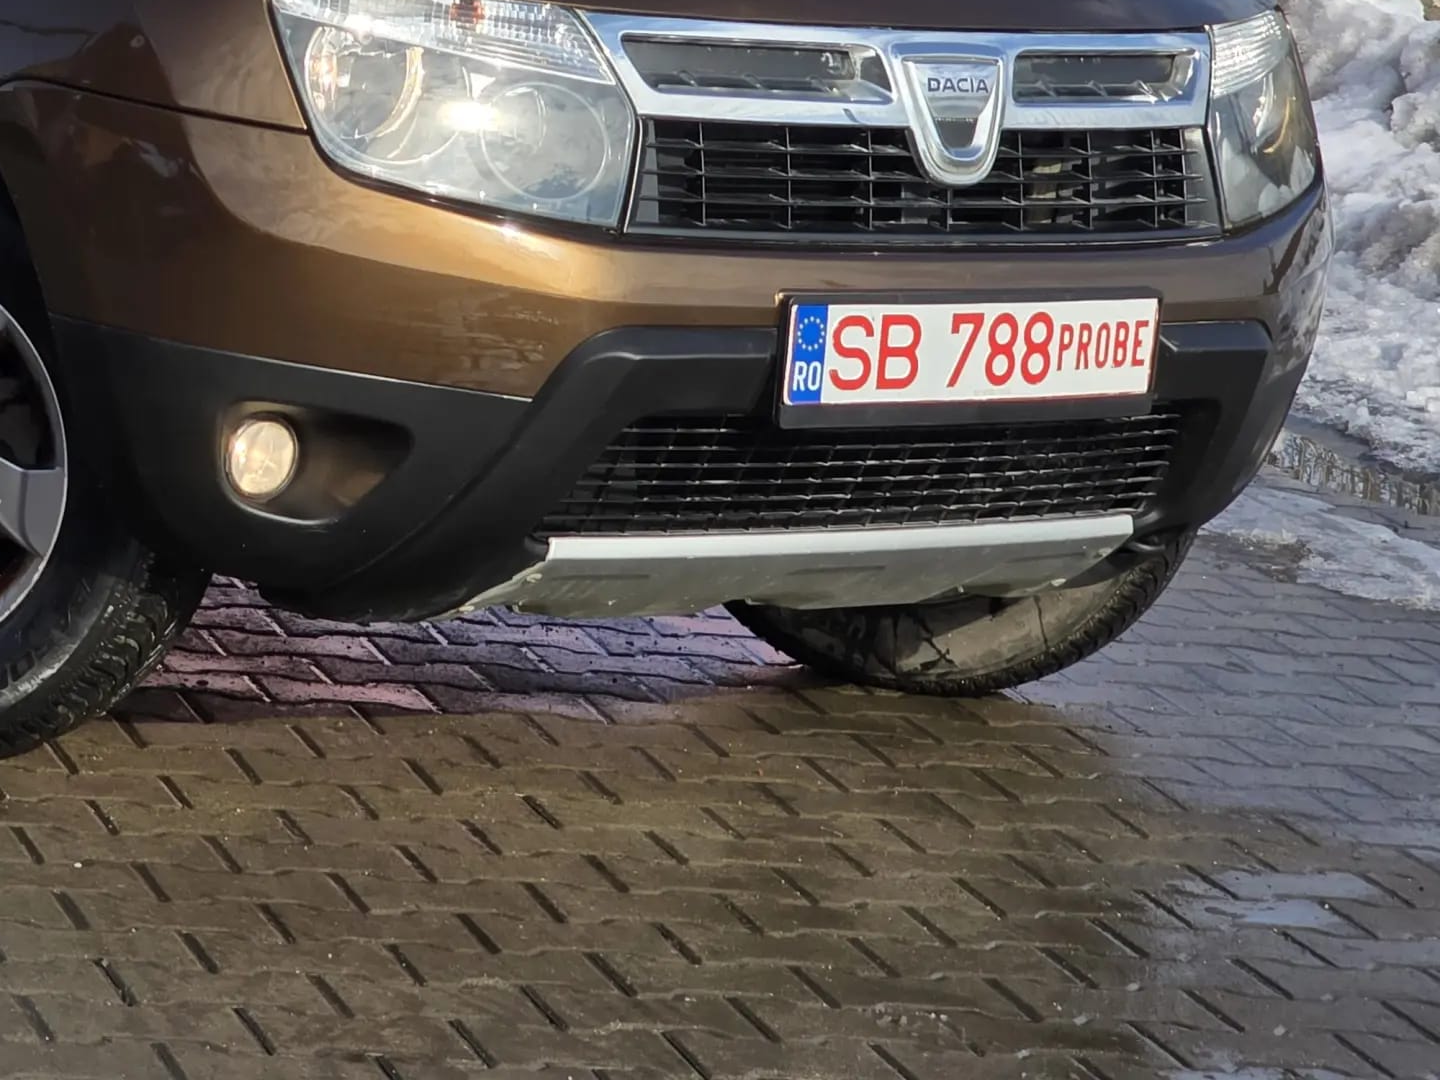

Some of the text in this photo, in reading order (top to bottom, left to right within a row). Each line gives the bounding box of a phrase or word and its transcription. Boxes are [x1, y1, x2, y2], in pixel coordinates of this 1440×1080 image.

[927, 76, 989, 94] DACIA
[829, 311, 1149, 391] SB 788 PROBE
[792, 360, 822, 392] RO
